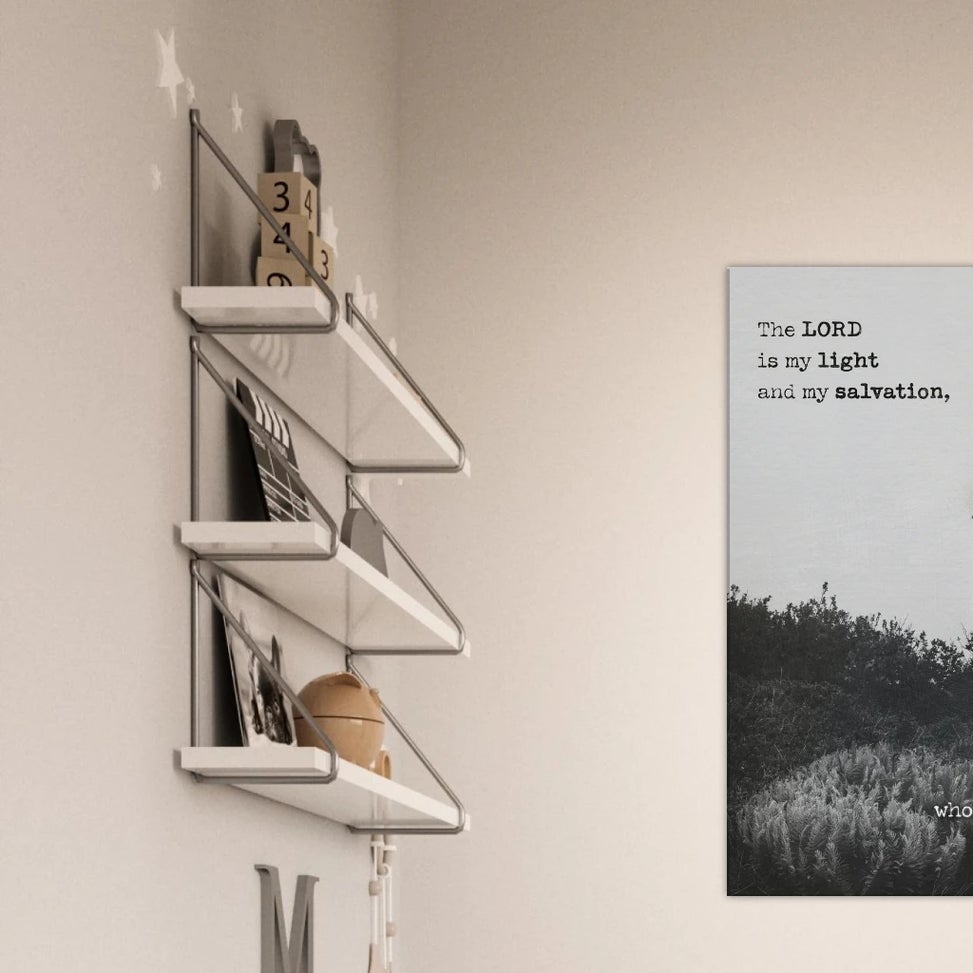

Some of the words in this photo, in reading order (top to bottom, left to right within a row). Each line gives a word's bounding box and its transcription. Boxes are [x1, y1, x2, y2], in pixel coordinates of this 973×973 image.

[273, 182, 290, 213] 3
[304, 189, 313, 220] 4
[273, 222, 292, 253] 4
[320, 249, 330, 280] 3
[757, 321, 795, 337] The
[801, 321, 862, 337] LORD
[757, 352, 778, 368] is
[785, 356, 812, 372] my
[817, 352, 879, 372] light
[757, 384, 795, 399] and
[802, 387, 829, 403] my
[835, 383, 951, 403] salvation,
